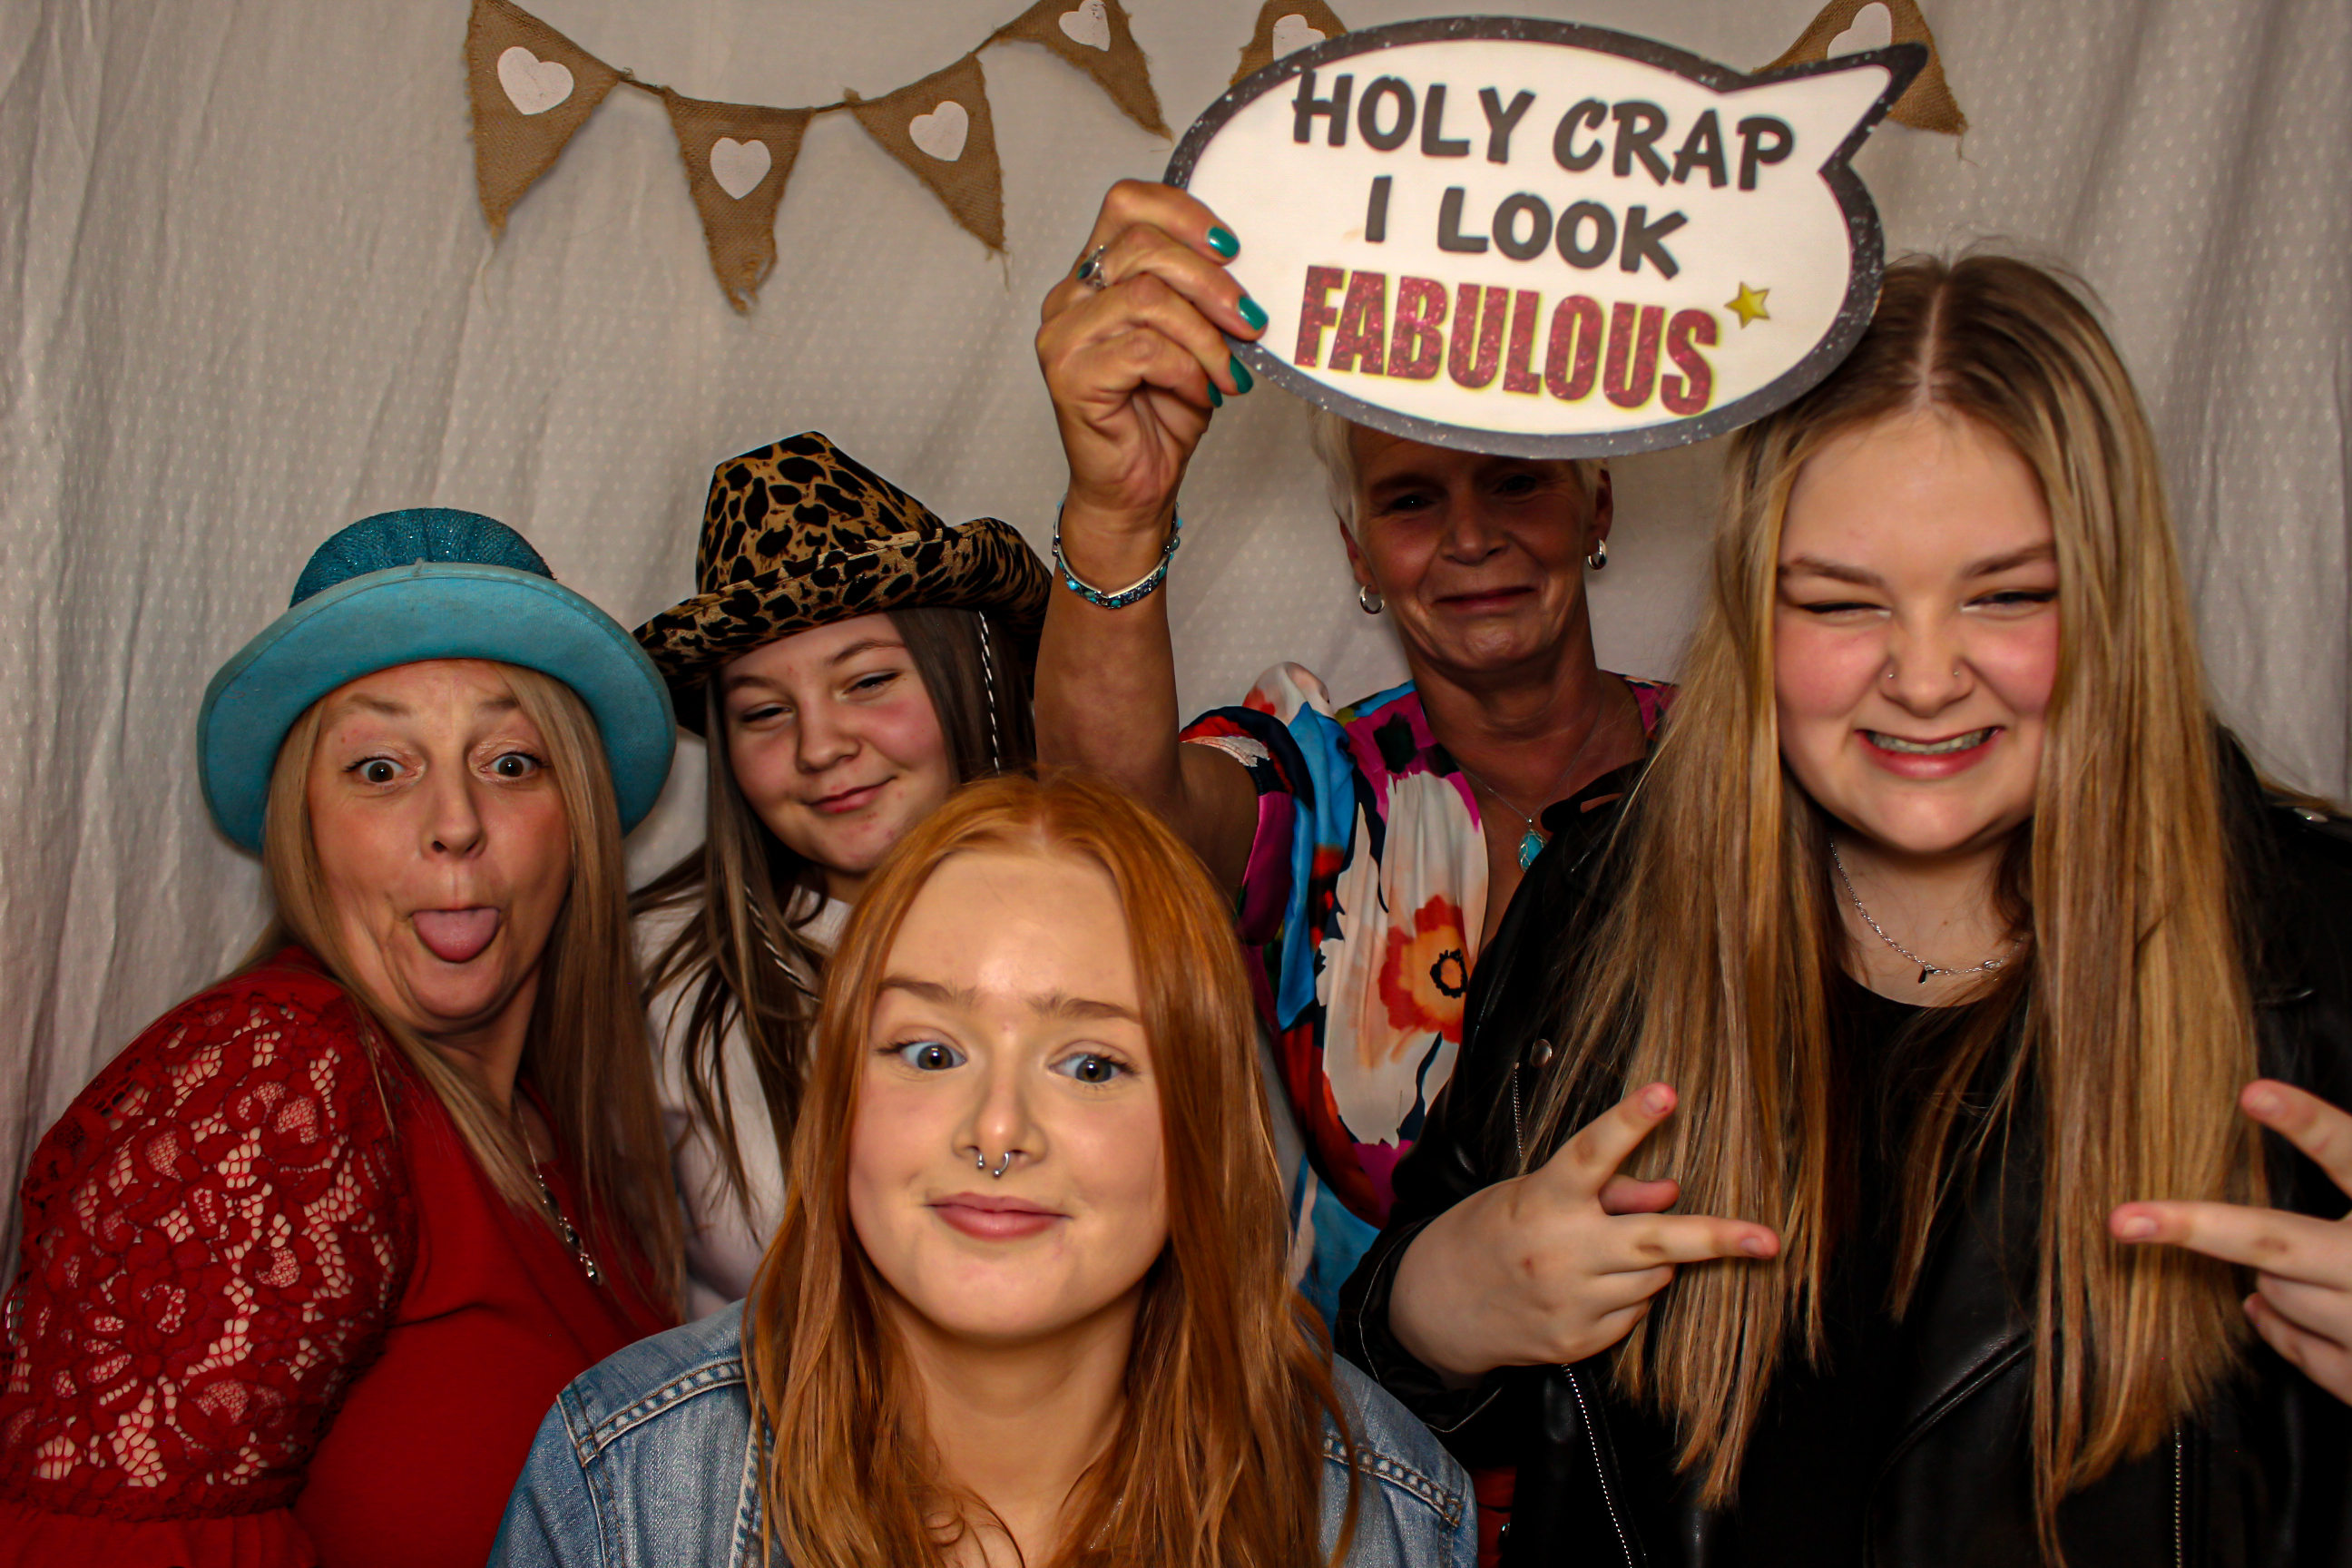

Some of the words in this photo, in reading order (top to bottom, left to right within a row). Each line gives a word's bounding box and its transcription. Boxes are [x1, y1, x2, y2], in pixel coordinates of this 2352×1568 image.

[1292, 70, 1536, 164] HOLY
[1553, 97, 1794, 191] CRAP
[1365, 175, 1392, 242] I
[1437, 186, 1688, 280] LOOK
[1294, 265, 1718, 416] FABULOUS
